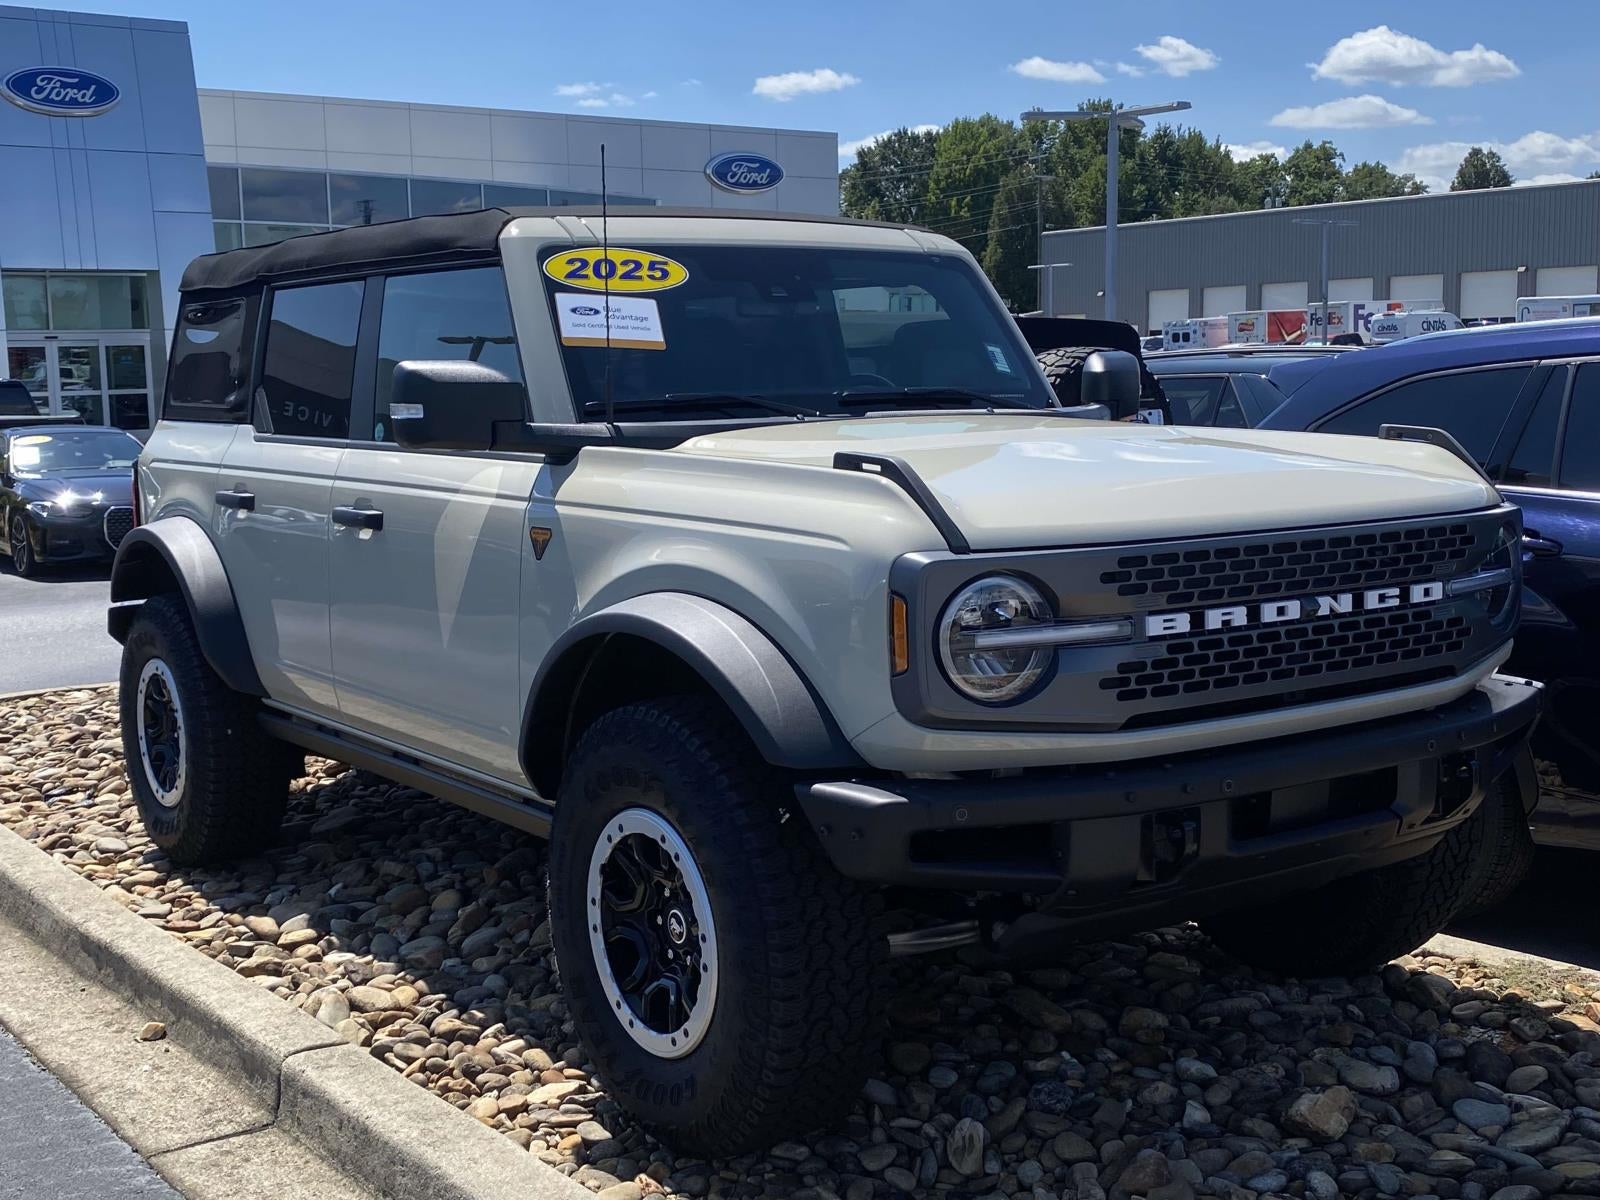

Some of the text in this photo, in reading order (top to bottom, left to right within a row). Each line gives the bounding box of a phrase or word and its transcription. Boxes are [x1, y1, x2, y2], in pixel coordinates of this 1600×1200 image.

[30, 74, 96, 103] Ford
[727, 161, 770, 184] Ford
[564, 257, 671, 281] 2025
[575, 306, 595, 315] Ford
[603, 305, 622, 313] Blue
[604, 313, 649, 322] Advantage
[1310, 312, 1344, 326] FeEx
[1145, 581, 1443, 637] BRONCO
